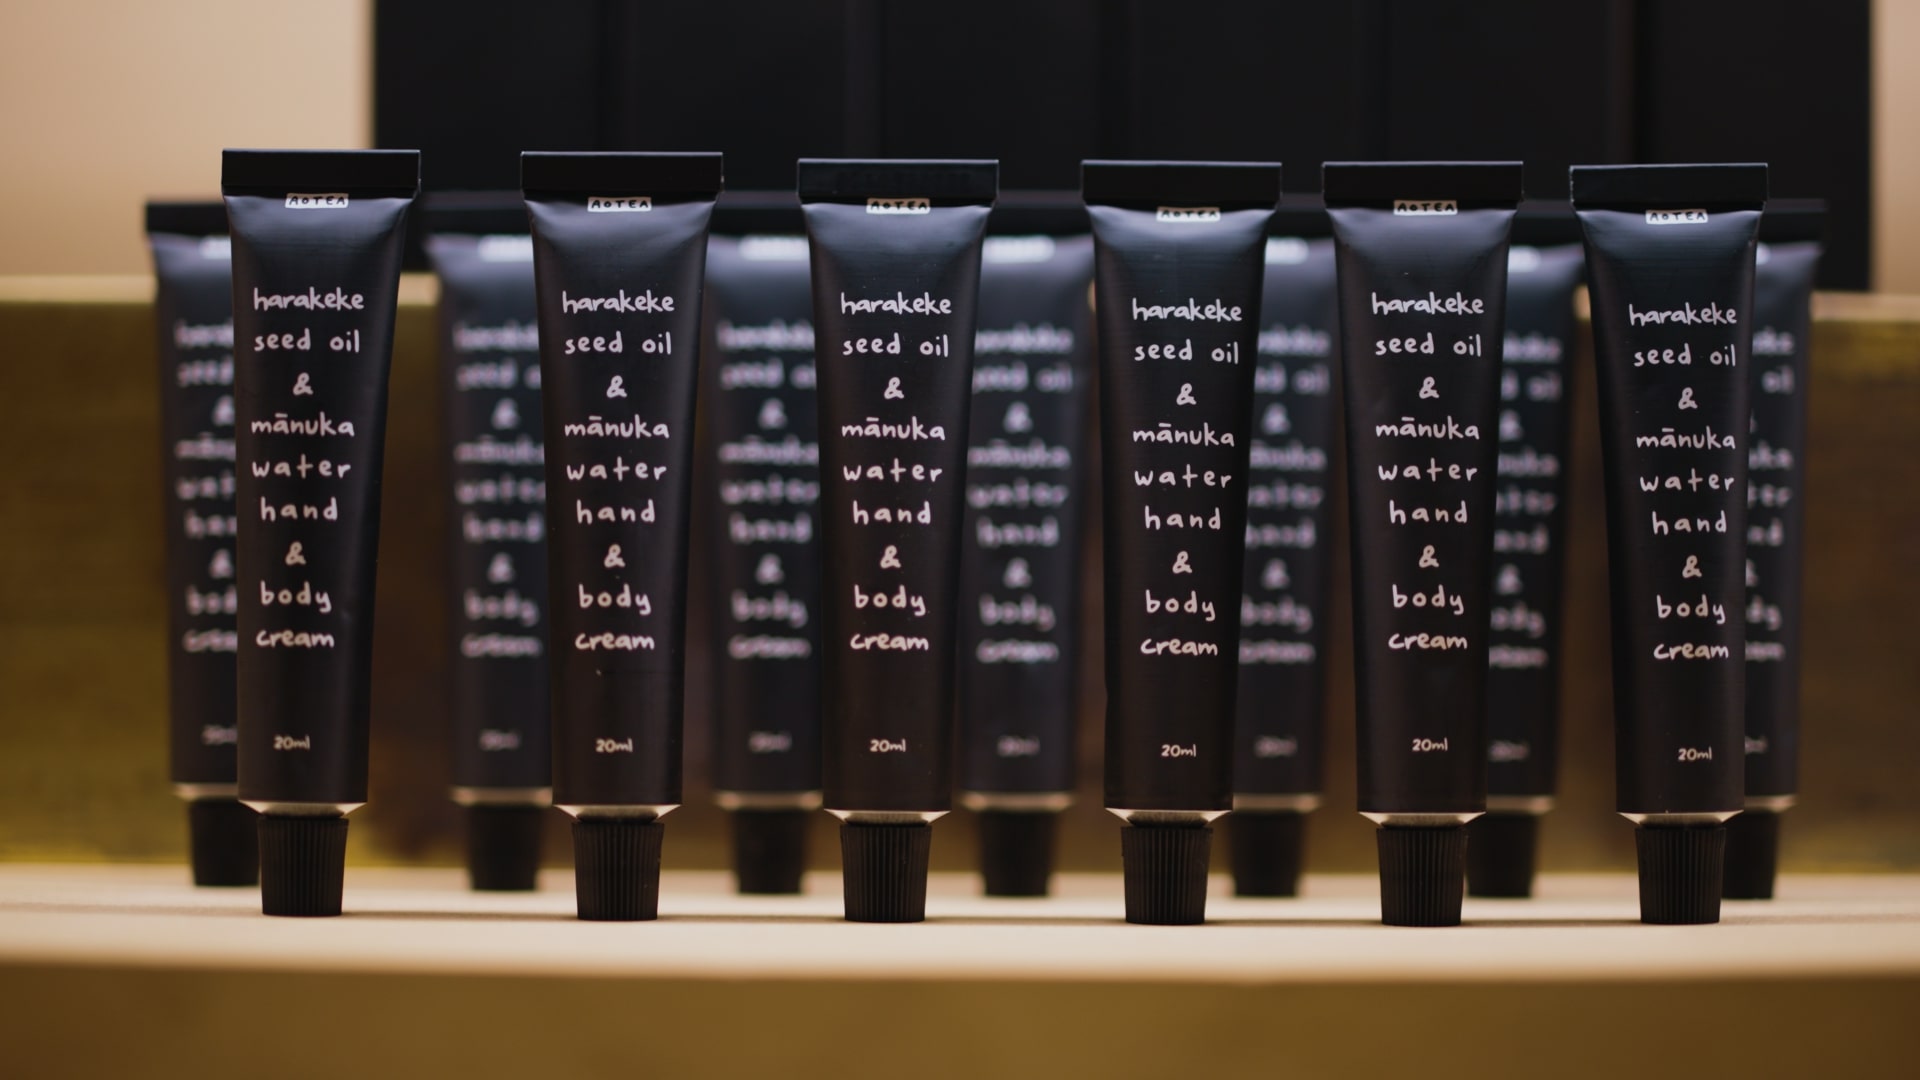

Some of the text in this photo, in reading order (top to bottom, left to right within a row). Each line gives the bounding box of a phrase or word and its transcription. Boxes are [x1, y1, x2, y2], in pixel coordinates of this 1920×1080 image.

[253, 286, 365, 312] harakeke
[561, 288, 675, 315] harakeke
[840, 290, 952, 316] harakeke
[1131, 297, 1243, 323] harakeke
[1371, 291, 1485, 316] harakeke
[1628, 301, 1738, 327] harakeke
[253, 327, 312, 352] seed
[329, 329, 360, 353] oil
[564, 330, 624, 355] seed
[641, 331, 672, 355] oil
[842, 331, 901, 356] seed
[919, 333, 949, 358] oil
[1133, 338, 1239, 365] seed oil
[1375, 331, 1435, 356] seed
[1452, 333, 1482, 358] oil
[1633, 342, 1736, 368] seed oil
[292, 372, 314, 396] &
[606, 374, 628, 399] &
[883, 376, 905, 400] &
[1175, 382, 1197, 406] &
[1418, 376, 1440, 400] &
[1677, 386, 1698, 410] &
[250, 411, 355, 437] mānuka
[564, 413, 670, 439] mānuka
[841, 415, 946, 441] mānuka
[1132, 421, 1235, 448] mānuka
[1375, 415, 1480, 440] mānuka
[1635, 425, 1736, 450] mānuka
[251, 453, 352, 479] water
[566, 455, 668, 482] water
[842, 457, 943, 483] water
[1133, 463, 1232, 489] water
[1377, 457, 1478, 482] water
[1639, 467, 1735, 492] water
[260, 496, 338, 522] hand
[576, 498, 656, 525] hand
[852, 499, 932, 526] hand
[1144, 505, 1222, 531] hand
[1389, 499, 1468, 525] hand
[1651, 509, 1727, 536] hand
[285, 541, 307, 566] &
[603, 543, 626, 569] &
[879, 544, 902, 569] &
[1171, 550, 1193, 575] &
[1418, 544, 1440, 569] &
[1681, 554, 1703, 579] &
[260, 580, 332, 614] body
[578, 583, 652, 616] body
[853, 583, 927, 617] body
[1145, 588, 1217, 623] body
[1391, 583, 1465, 616] body
[1656, 593, 1726, 625] body
[255, 629, 335, 649] cream
[574, 632, 656, 651] cream
[849, 632, 930, 652] cream
[1139, 638, 1219, 657] cream
[1387, 632, 1468, 651] cream
[1653, 642, 1730, 661] cream
[272, 734, 311, 750] 20ml
[595, 738, 634, 753] 20ml
[869, 738, 907, 753] 20ml
[1160, 743, 1197, 758] 20ml
[1411, 737, 1449, 752] 20ml
[1677, 746, 1713, 761] 20ml
